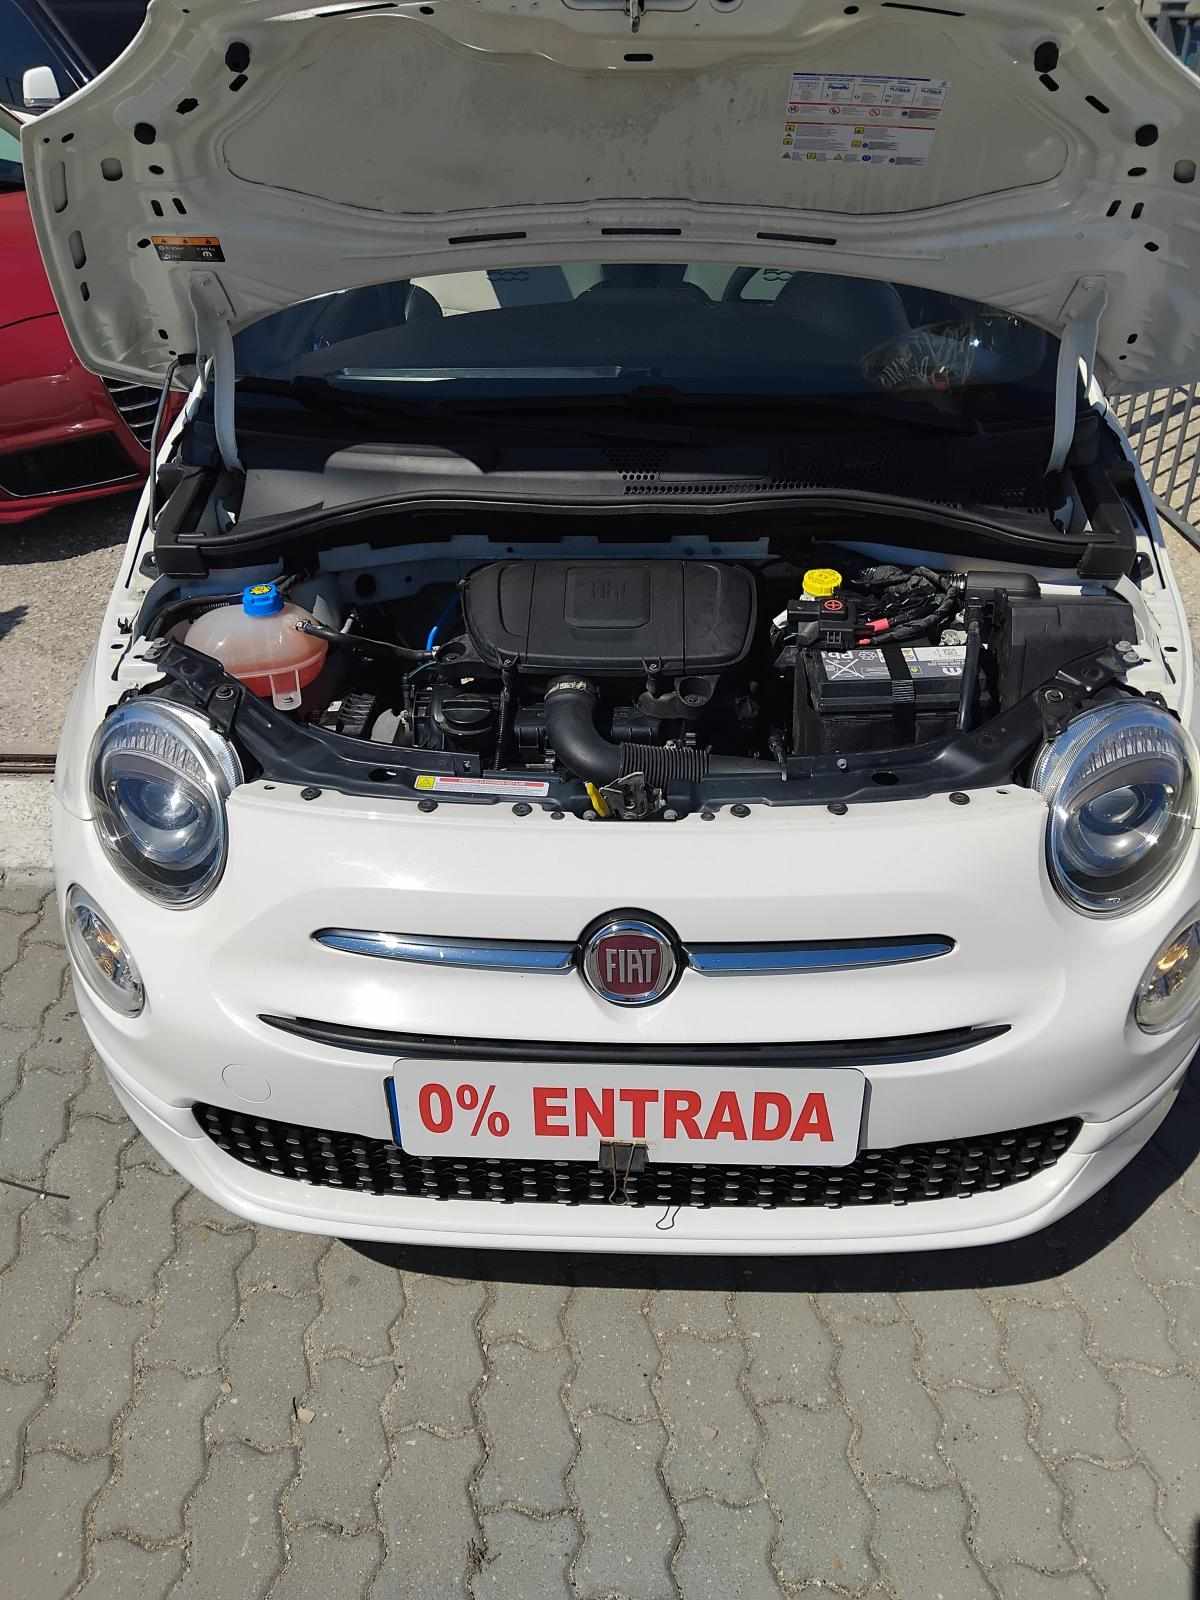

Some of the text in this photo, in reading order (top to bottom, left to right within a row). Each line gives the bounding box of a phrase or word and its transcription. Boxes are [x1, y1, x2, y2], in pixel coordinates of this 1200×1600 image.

[606, 948, 657, 984] FIAT
[418, 1083, 835, 1143] 0% ENTRADA
